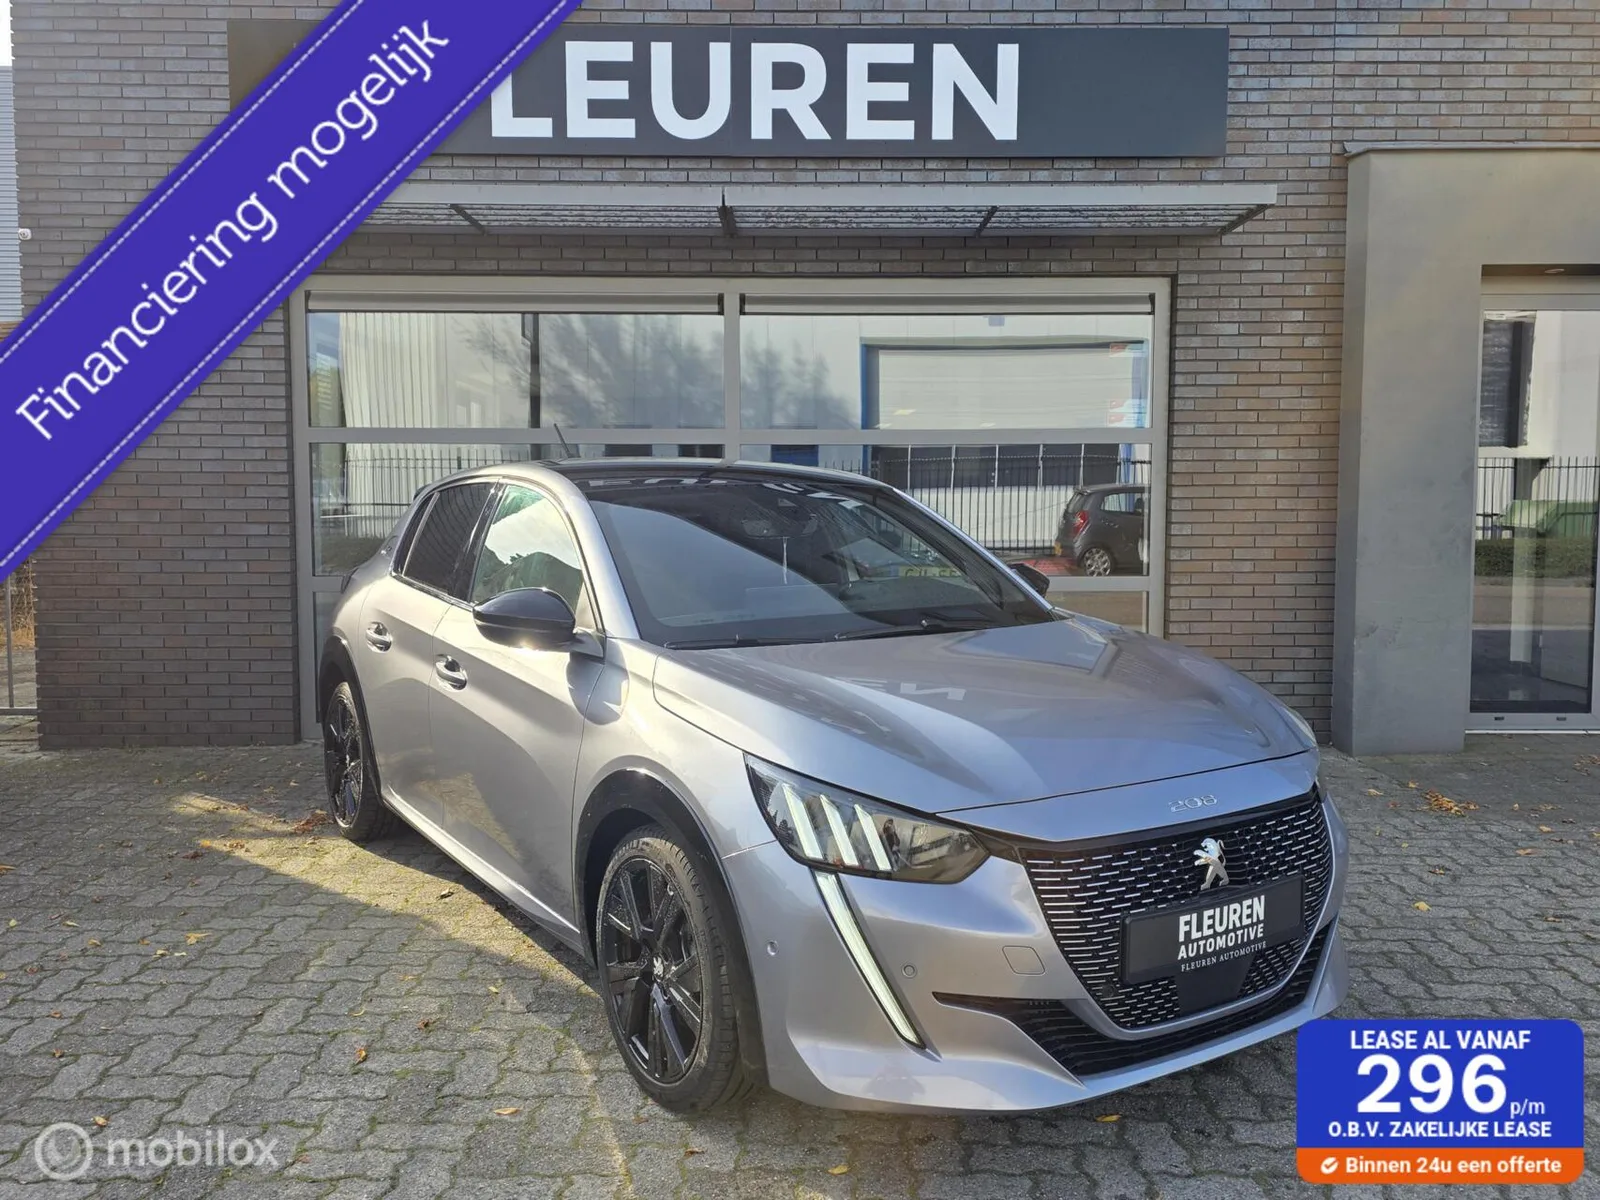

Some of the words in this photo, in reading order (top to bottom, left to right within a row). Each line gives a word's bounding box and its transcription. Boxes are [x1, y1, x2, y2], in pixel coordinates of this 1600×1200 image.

[1168, 794, 1218, 813] 208
[1178, 894, 1265, 943] FLEUREN
[1177, 922, 1265, 960] AUTOMOTIVE
[1180, 955, 1218, 973] FLEUREN
[1218, 940, 1267, 962] AUTOMOTIVE
